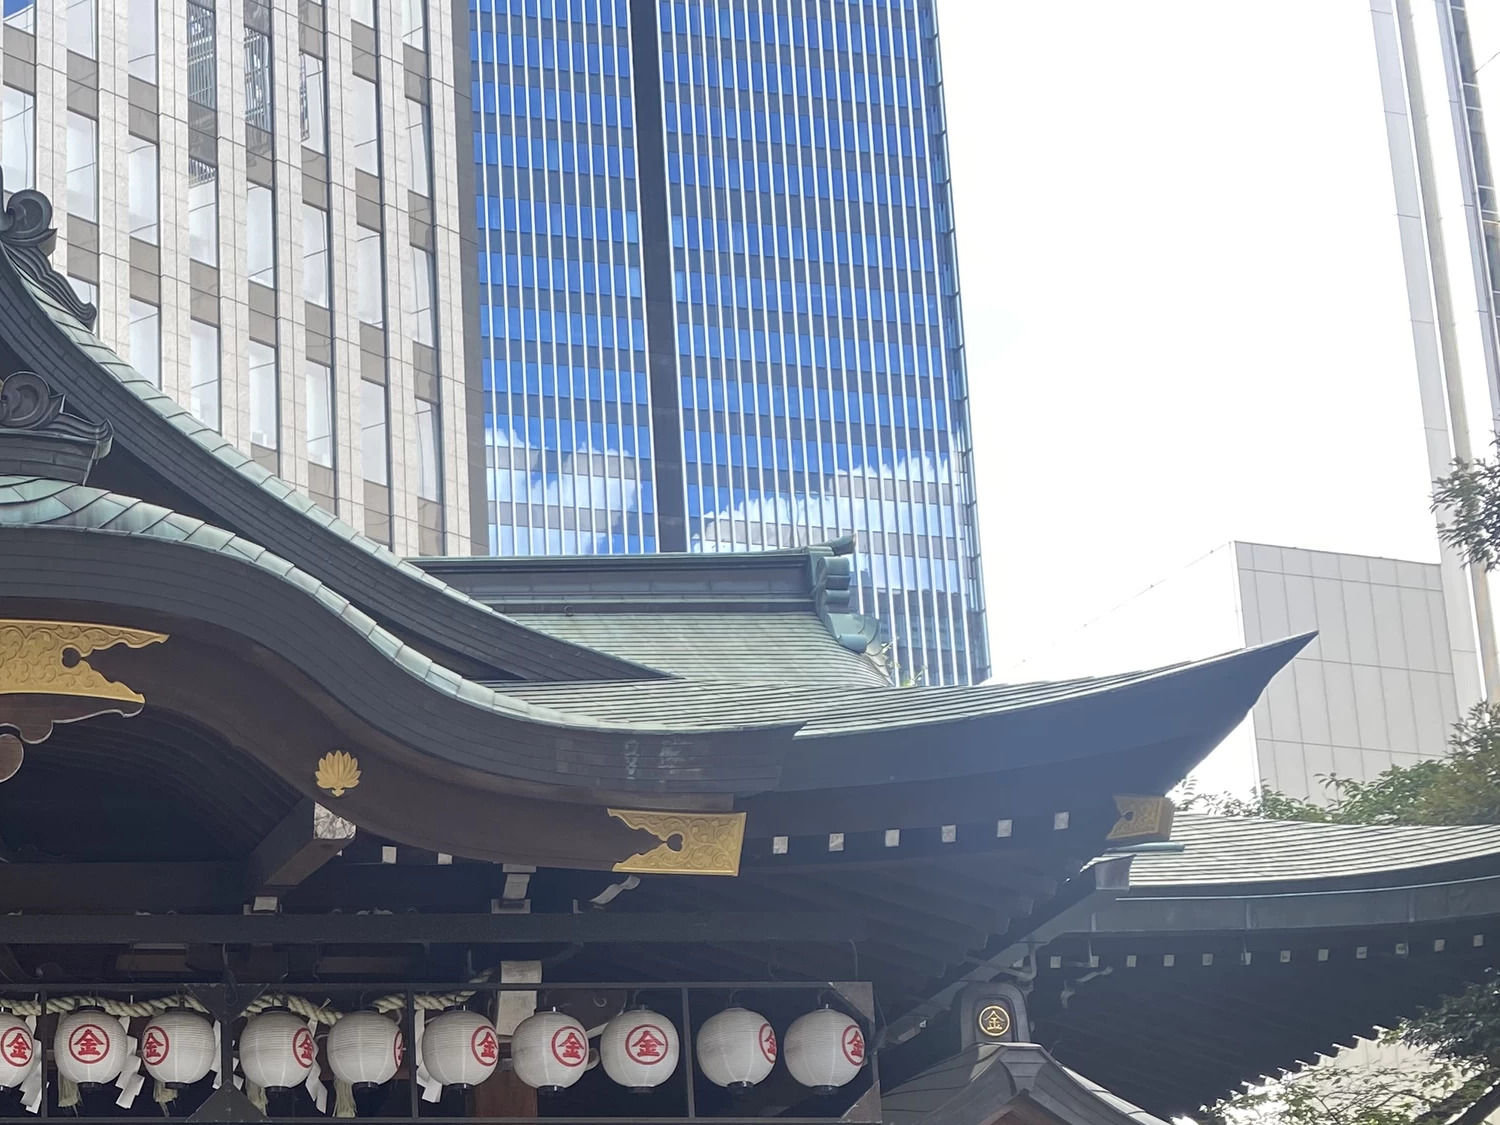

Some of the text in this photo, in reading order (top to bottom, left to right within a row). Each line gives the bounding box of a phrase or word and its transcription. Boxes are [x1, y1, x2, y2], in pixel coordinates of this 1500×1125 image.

[984, 1010, 1005, 1030] 金
[6, 1033, 32, 1059] 金
[73, 1029, 105, 1056] 金
[143, 1033, 162, 1058] 金
[298, 1034, 314, 1060] 金
[476, 1032, 498, 1059] 金
[561, 1032, 589, 1059] 金
[632, 1031, 664, 1057] 金
[847, 1031, 864, 1057] 金
